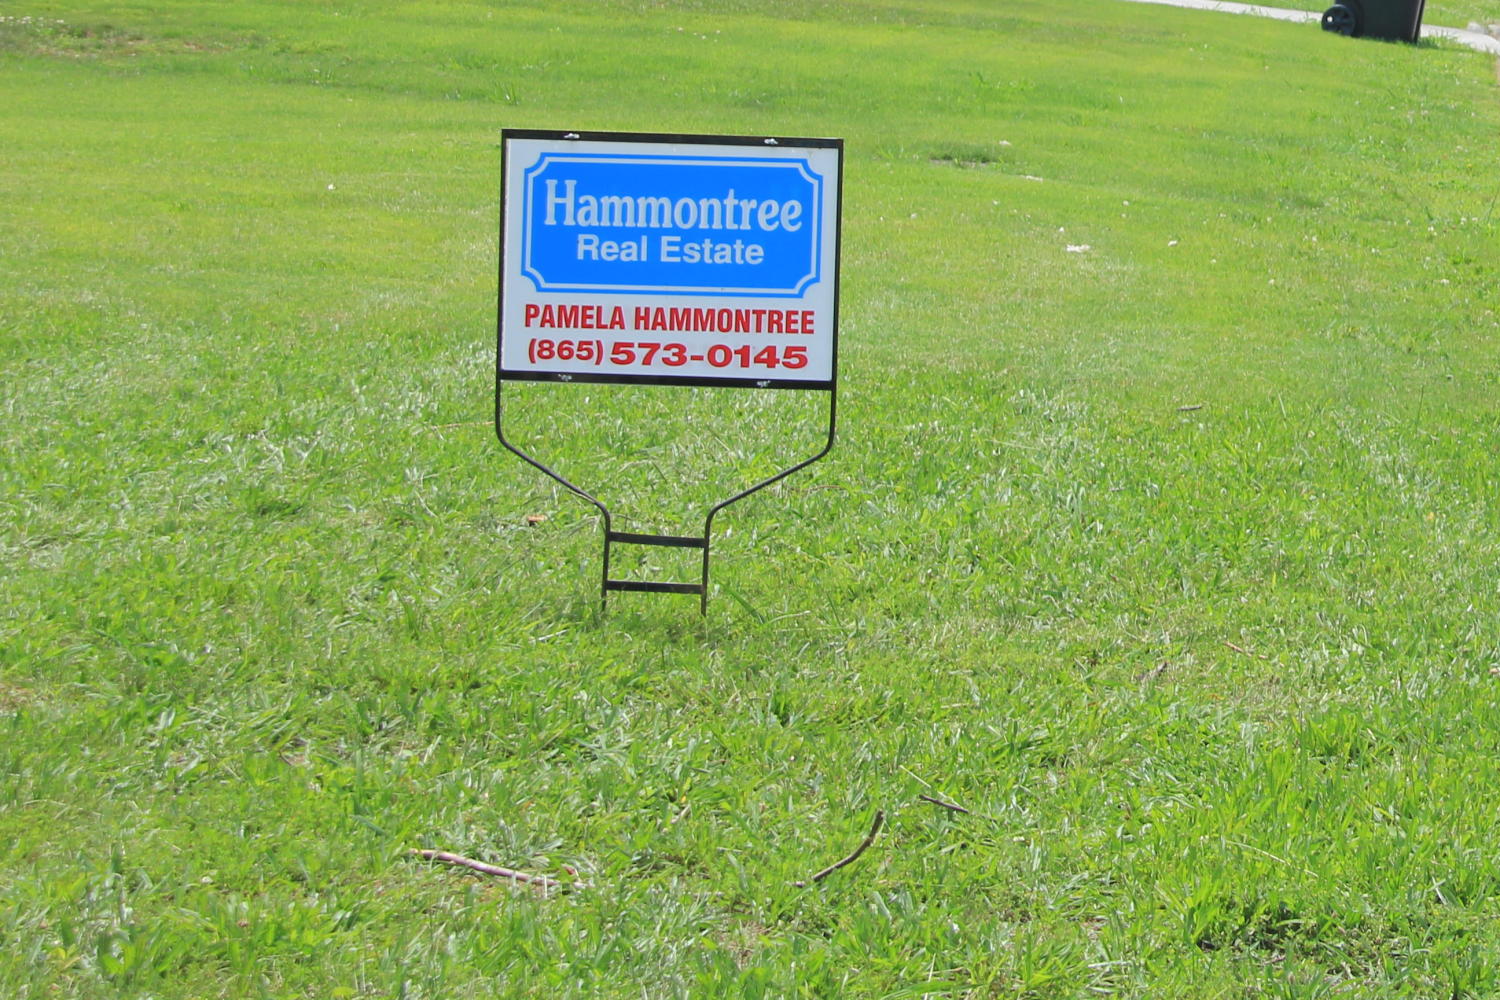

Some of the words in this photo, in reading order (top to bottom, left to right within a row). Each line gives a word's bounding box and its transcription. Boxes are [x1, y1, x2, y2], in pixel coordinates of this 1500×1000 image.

[544, 179, 803, 232] Hammontree
[576, 234, 648, 262] Real
[660, 236, 765, 265] Estate
[525, 304, 626, 330] PAMELA
[634, 307, 816, 334] HAMMONTREE
[528, 339, 604, 366] (865)
[610, 342, 809, 369] 573-0145
